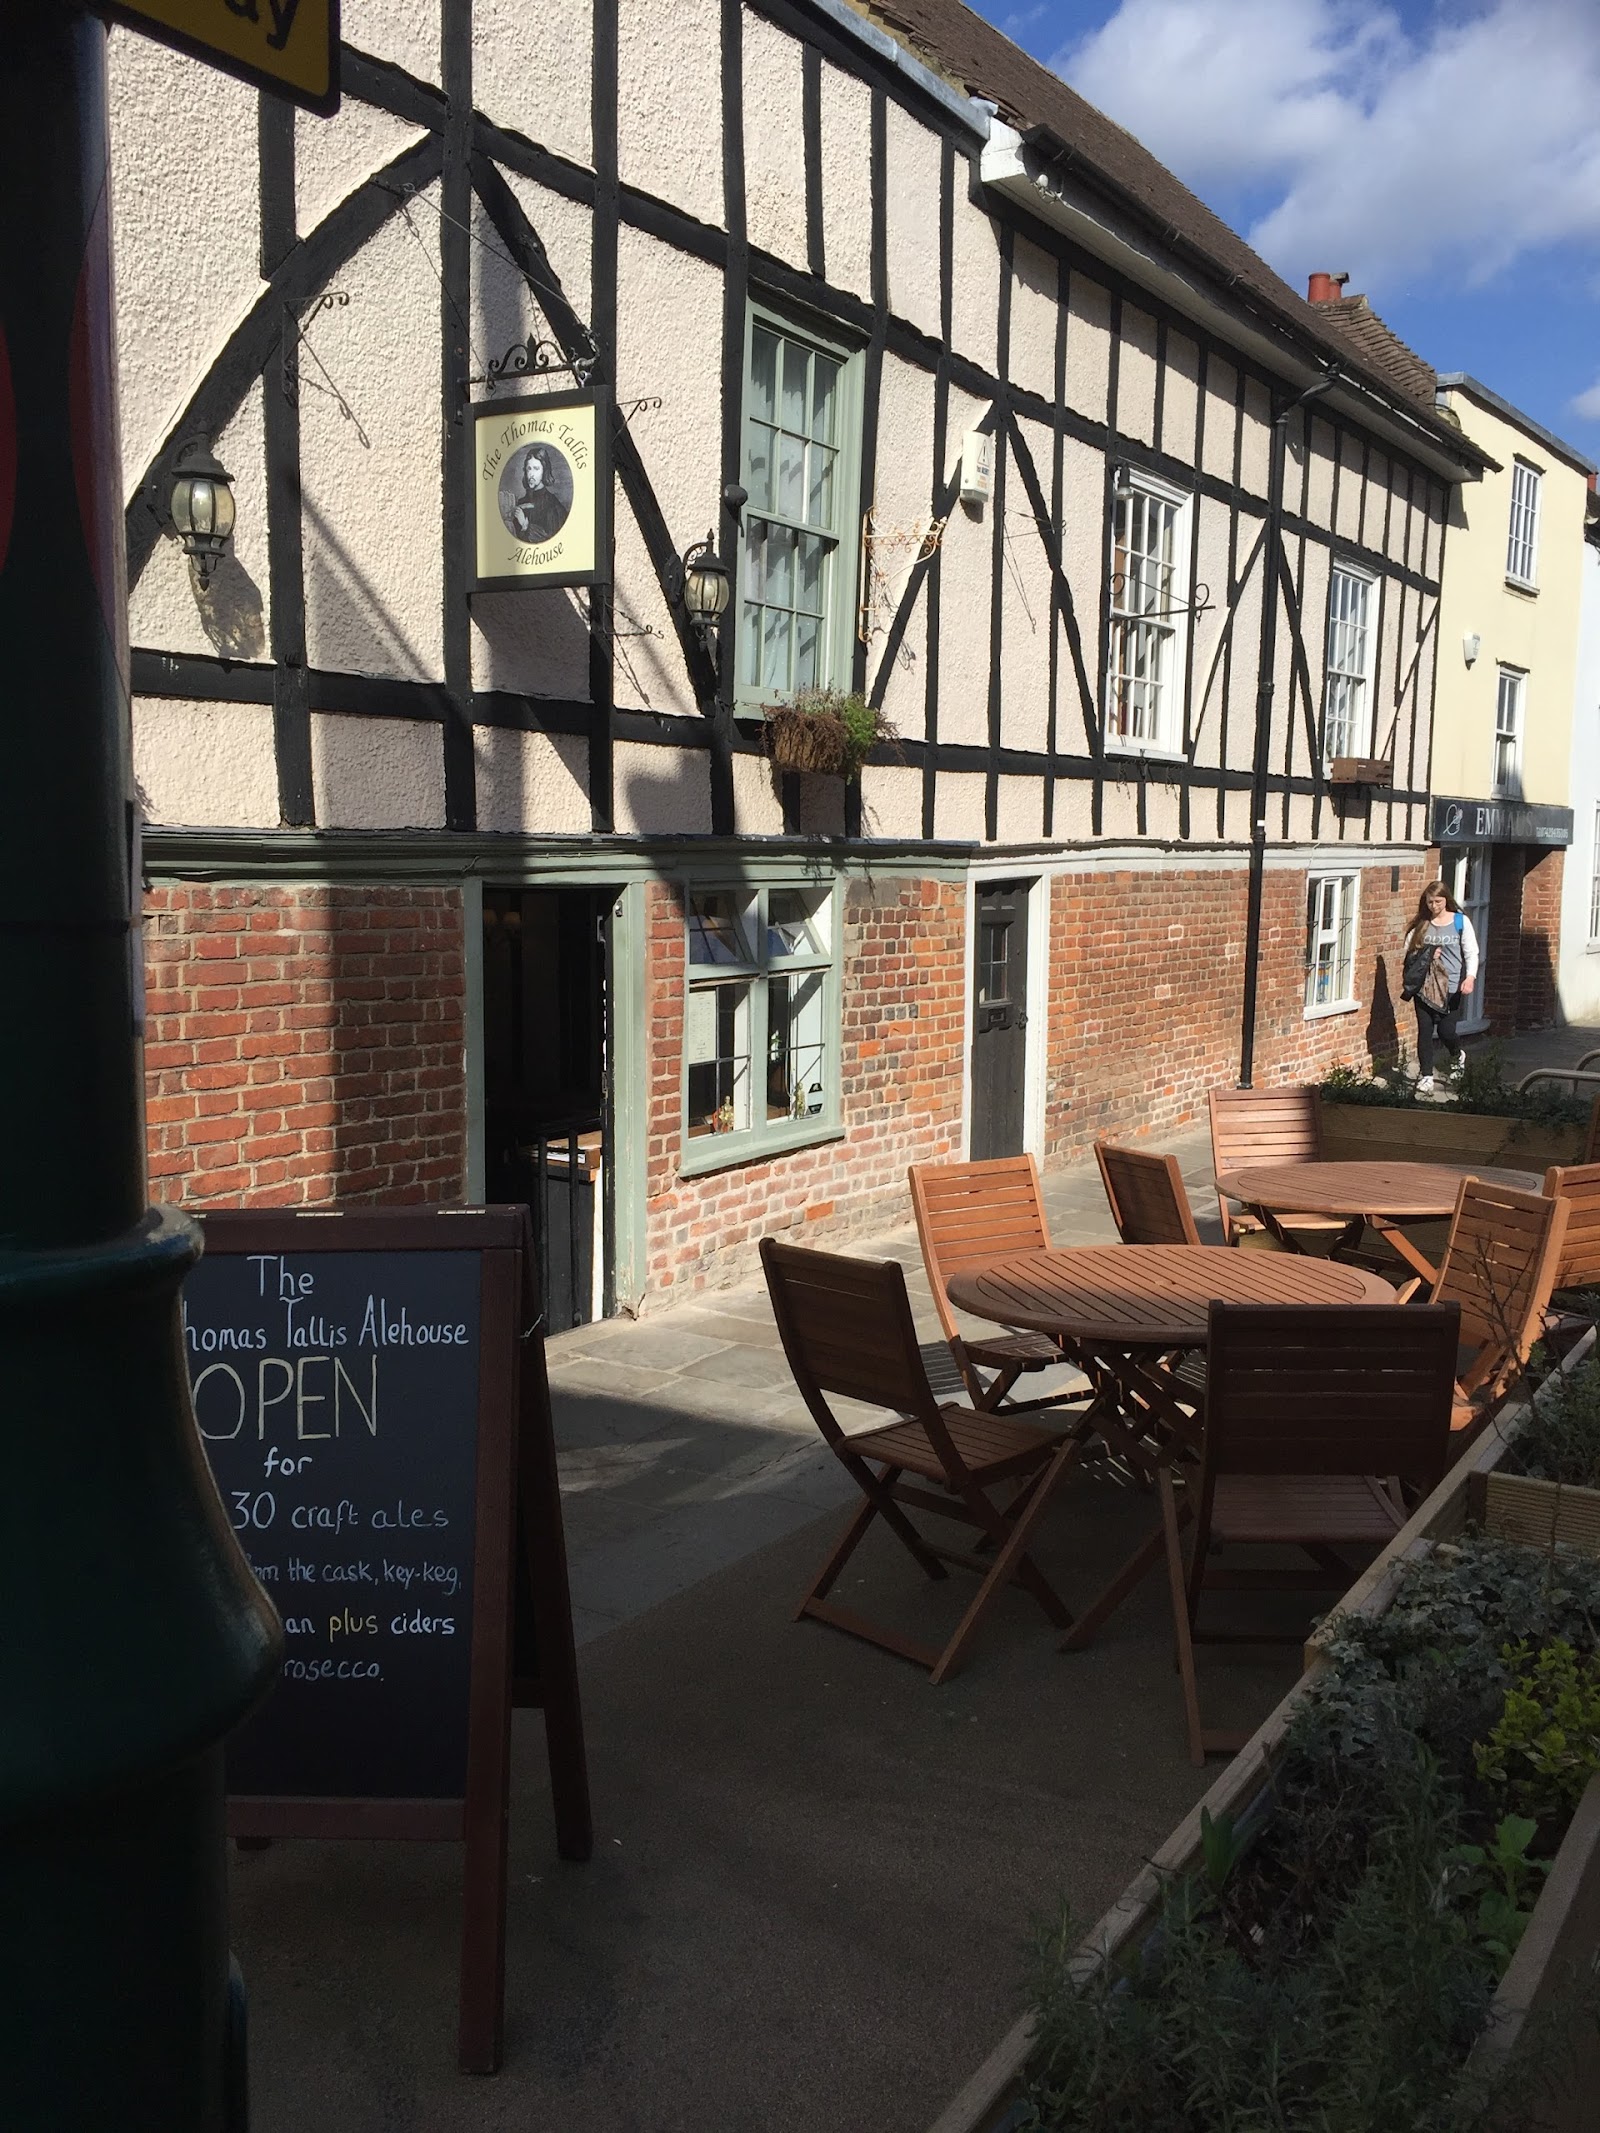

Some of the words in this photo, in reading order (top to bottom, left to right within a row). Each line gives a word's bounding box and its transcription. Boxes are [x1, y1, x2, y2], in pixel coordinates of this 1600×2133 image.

[483, 448, 502, 481] The
[501, 419, 555, 447] Thomas
[558, 424, 588, 470] Tallis
[507, 542, 564, 566] Alehouse
[1475, 807, 1533, 836] EMMAUS
[246, 1255, 315, 1296] The
[183, 1300, 267, 1351] homas
[279, 1296, 348, 1348] Tallis
[358, 1293, 469, 1348] Alehouse
[192, 1354, 378, 1440] OPEN
[264, 1446, 313, 1478] for
[230, 1491, 276, 1531] 30
[291, 1500, 359, 1534] craft
[371, 1500, 449, 1529] ales
[287, 1557, 316, 1583] the
[322, 1559, 378, 1586] cask,
[384, 1559, 462, 1595] key-keg,
[284, 1618, 315, 1634] an
[329, 1607, 378, 1642] plus
[390, 1608, 455, 1635] ciders
[284, 1658, 385, 1682] rosecco.
